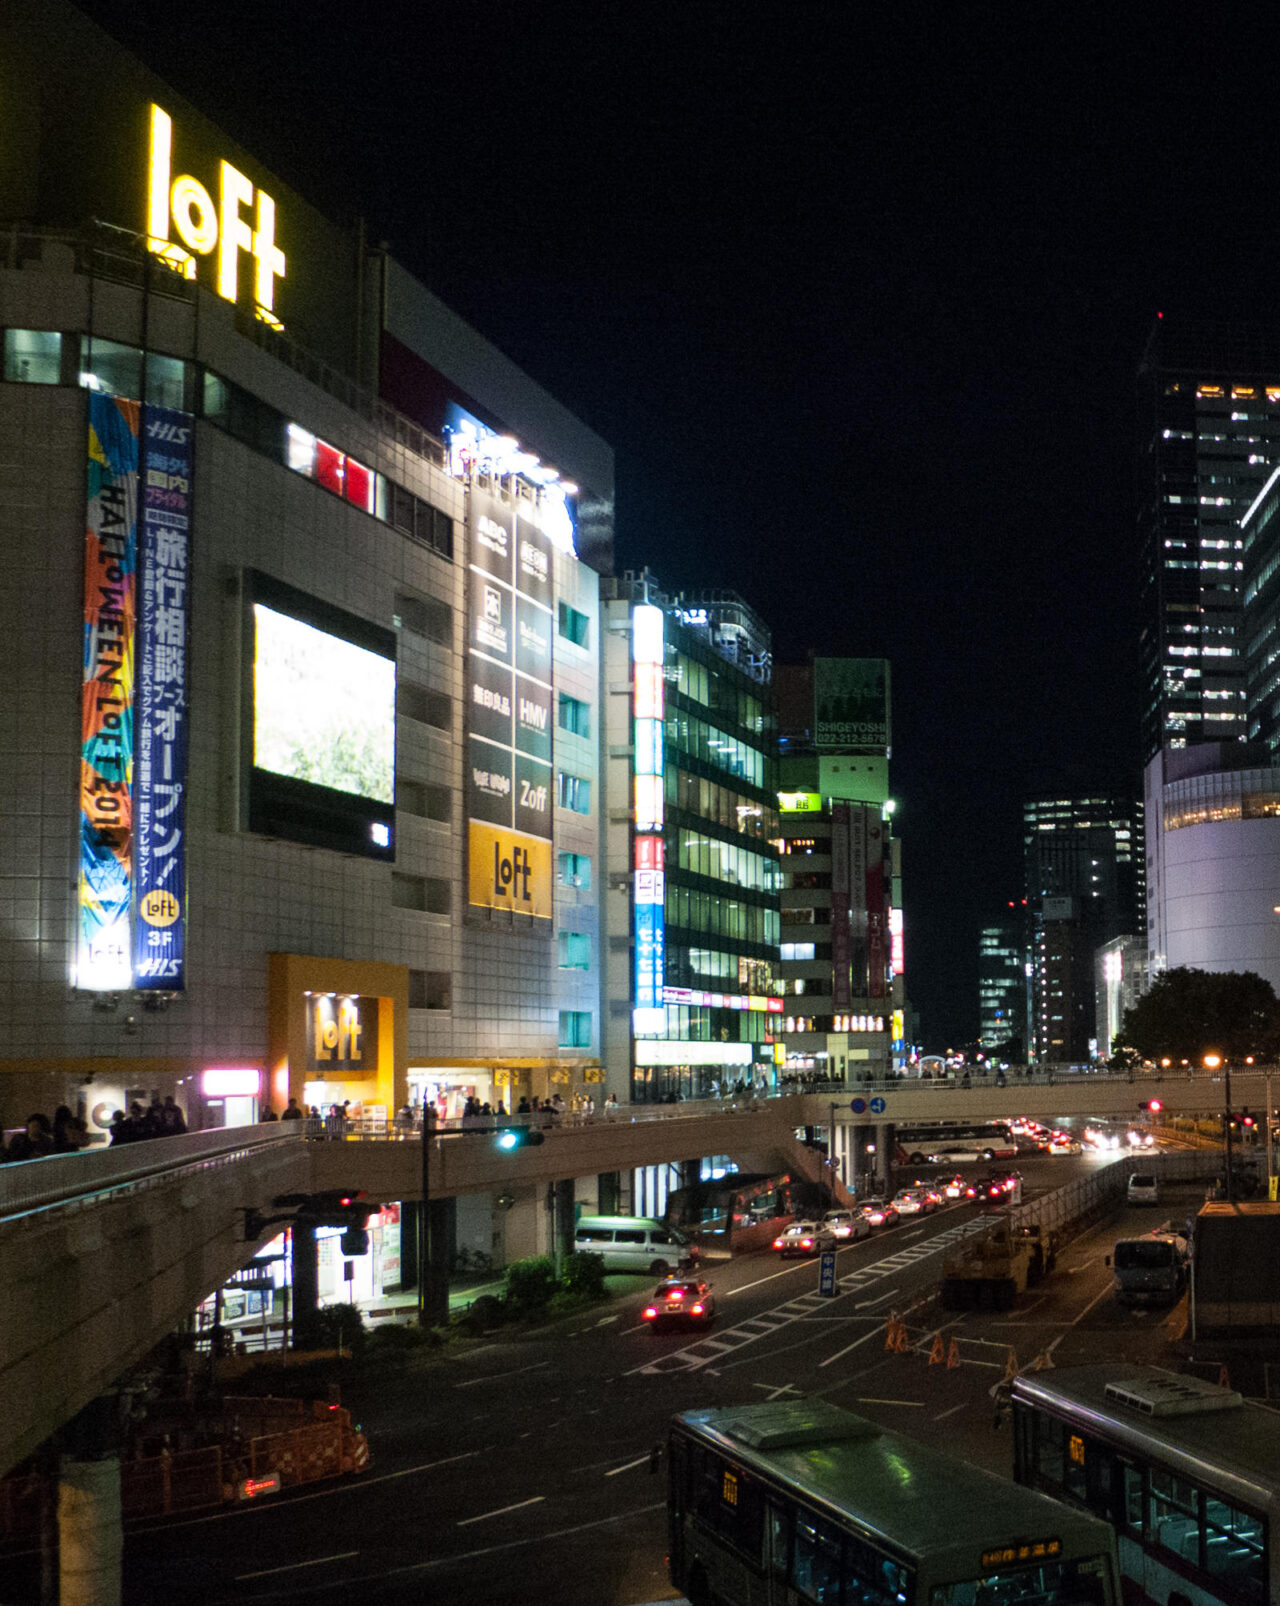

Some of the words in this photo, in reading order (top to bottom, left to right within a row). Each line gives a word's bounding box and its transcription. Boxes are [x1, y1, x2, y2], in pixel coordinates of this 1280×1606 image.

[146, 421, 190, 444] HIS
[147, 469, 188, 494] 国内
[477, 515, 507, 546] ABC
[520, 697, 547, 730] HMV
[818, 722, 886, 732] SHIGEYOSHI
[520, 780, 547, 812] Zoff
[94, 778, 121, 847] 2014
[148, 931, 173, 946] 3F
[136, 958, 182, 977] HIS
[637, 928, 653, 1001] 七十七
[822, 1256, 834, 1289] 中央
